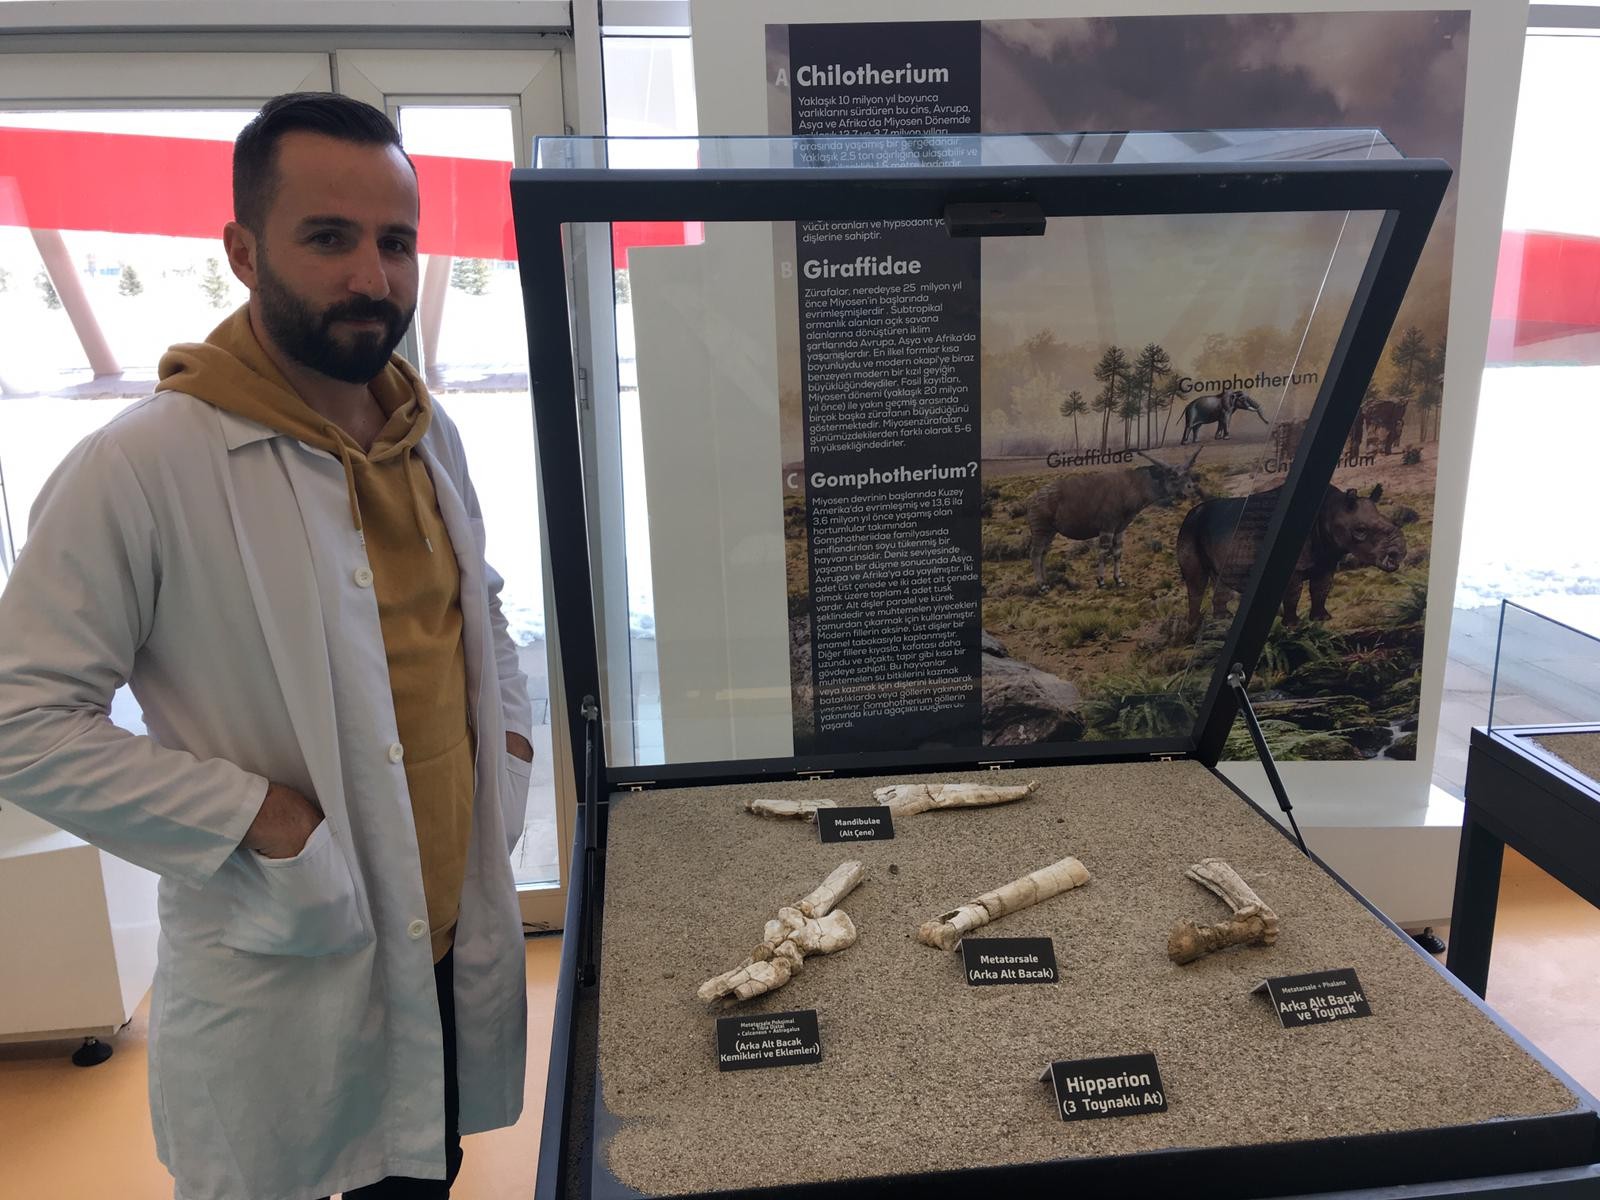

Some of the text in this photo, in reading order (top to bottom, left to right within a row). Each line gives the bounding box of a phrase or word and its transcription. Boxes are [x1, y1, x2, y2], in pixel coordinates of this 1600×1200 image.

[775, 68, 788, 86] A
[796, 63, 949, 87] Chilotherium
[838, 96, 850, 105] 10
[852, 95, 883, 107] milyon
[885, 94, 896, 106] yıl
[898, 94, 938, 105] boyunca
[851, 106, 893, 116] sürdüren
[896, 106, 908, 115] bu
[799, 120, 823, 131] Asya
[884, 117, 923, 129] Miyosen
[925, 115, 971, 125] Dönemde
[883, 217, 933, 230] hypsodont
[803, 230, 882, 244] dişlerine sahiptir.
[781, 262, 792, 279] B
[803, 256, 921, 279] Giraffidae
[852, 285, 901, 296] neredeyse
[903, 284, 916, 292] 25
[920, 283, 950, 293] milyon
[952, 281, 962, 292] yıl
[805, 300, 827, 308] önce
[910, 325, 931, 334] iklim
[898, 336, 921, 347] Asya
[807, 360, 861, 372] boyunluydu
[875, 358, 912, 367] modern
[952, 355, 974, 363] biraz
[808, 373, 851, 382] benzeyen
[854, 369, 889, 378] modern
[891, 368, 903, 376] bir
[808, 393, 846, 403] Miyosen
[847, 390, 882, 399] dönemi
[924, 386, 937, 395] 20
[939, 385, 968, 396] milyon
[924, 425, 953, 435] olarak
[954, 424, 972, 433] 5-6
[1046, 449, 1134, 470] Giraffidae
[787, 473, 798, 489] C
[810, 462, 978, 489] Gomphotherium?
[812, 497, 849, 507] Miyosen
[851, 493, 887, 503] devrinin
[938, 488, 964, 498] Kuzey
[830, 515, 859, 525] milyon
[872, 513, 894, 521] önce
[934, 508, 953, 517] olan
[813, 524, 866, 535] hortumlular
[814, 555, 848, 565] hayvan
[884, 550, 908, 559] Deniz
[910, 545, 960, 558] seviyesinde
[815, 583, 837, 593] adet
[838, 582, 852, 591] üst
[900, 577, 909, 586] iki
[911, 575, 932, 585] adet
[933, 574, 945, 584] alt
[816, 583, 952, 602] olmak üzere toplam 4 adet tusk
[846, 600, 859, 609] Alt
[886, 595, 917, 608] paralel
[930, 592, 954, 602] kürek
[834, 818, 880, 826] Mandibulae
[840, 828, 875, 838] (Alt Çene)
[980, 954, 1038, 964] Metatarsale
[969, 968, 1054, 980] (Arka Alt Bacak)
[1280, 1001, 1307, 1013] Arka
[1310, 997, 1327, 1008] Alt
[1297, 1003, 1356, 1021] ve Toynak
[720, 1050, 762, 1062] Kemikleri
[776, 1042, 820, 1056] Eklemleri)
[736, 1037, 802, 1052] (Arka Alt Bacak
[1066, 1072, 1151, 1096] Hipparion
[1063, 1091, 1163, 1115] (3 Toynaklı At)
